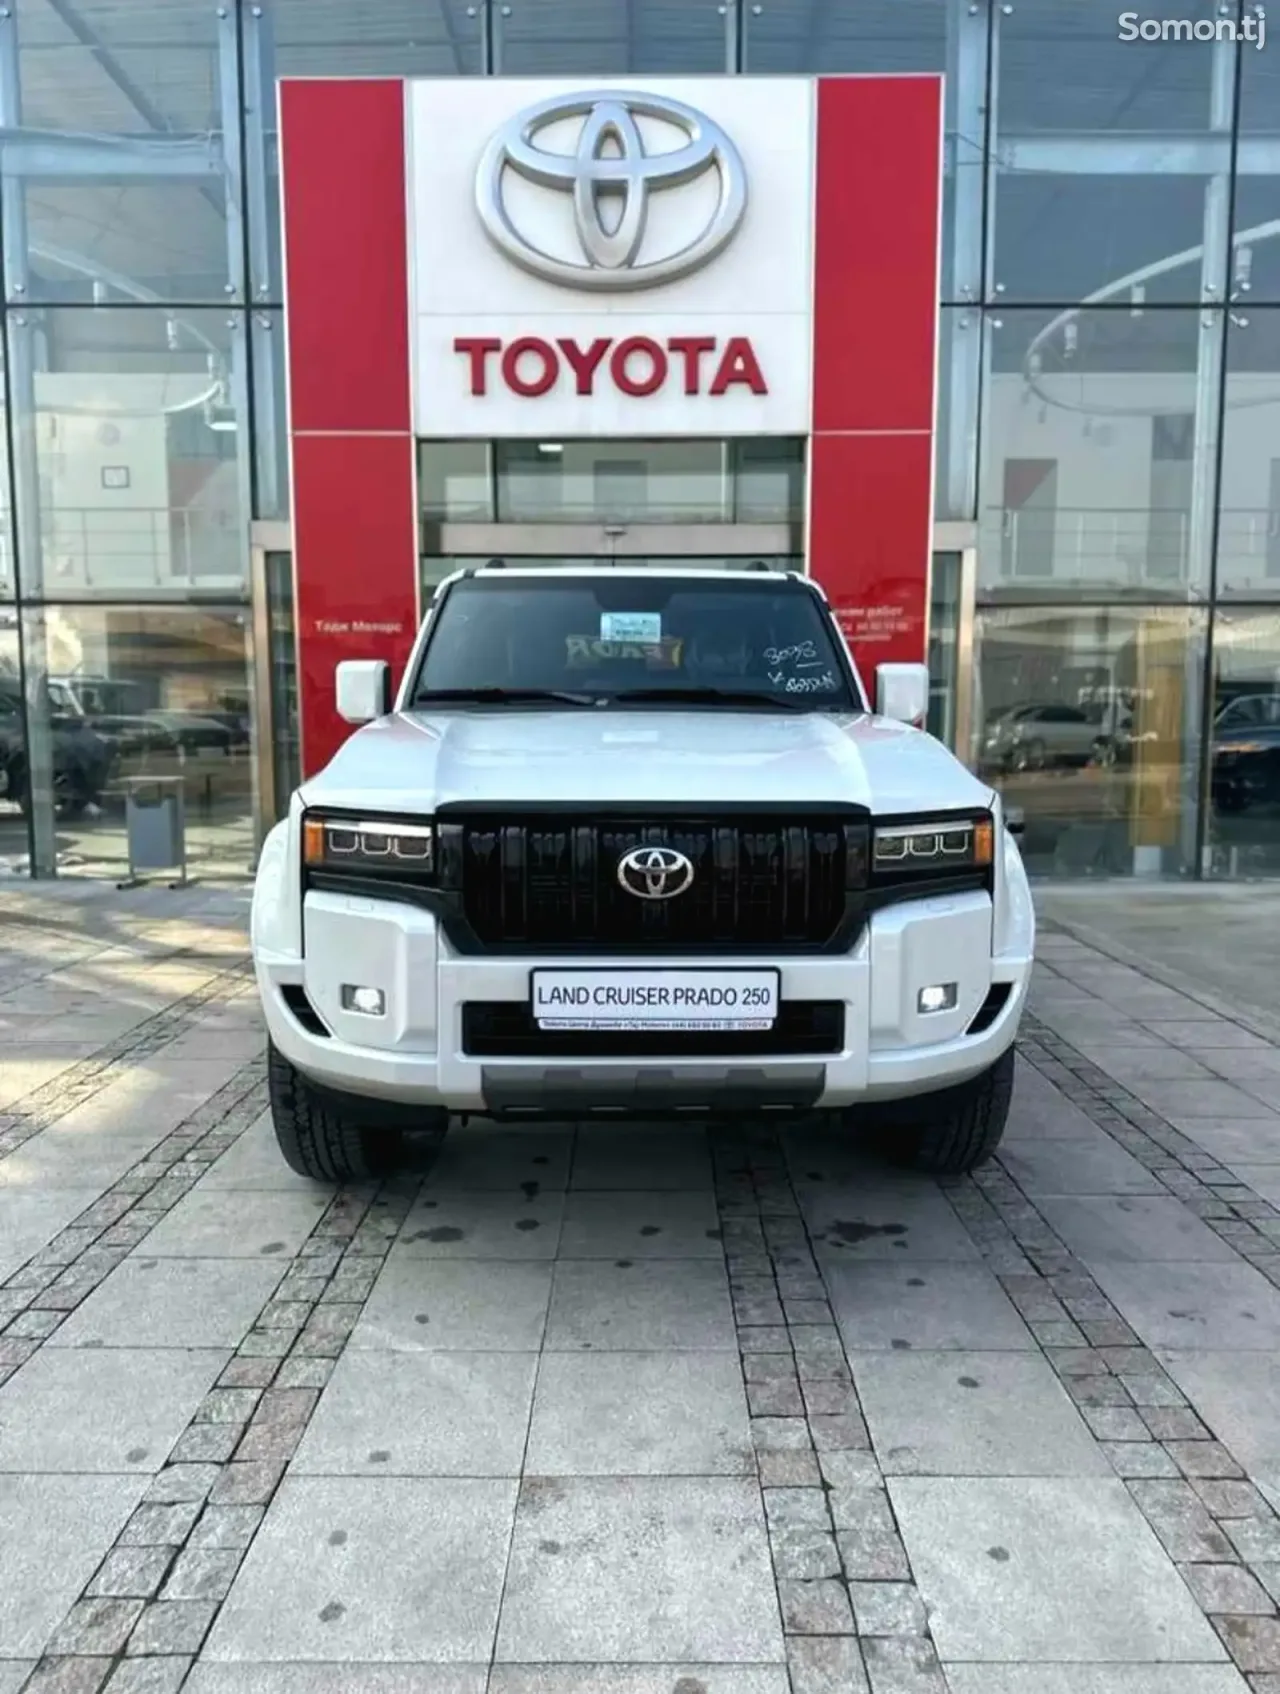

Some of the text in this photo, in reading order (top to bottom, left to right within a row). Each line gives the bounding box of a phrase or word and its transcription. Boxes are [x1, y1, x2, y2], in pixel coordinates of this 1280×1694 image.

[453, 336, 768, 397] TOYOTA
[538, 986, 771, 1006] LAND CRUISER PRADO 250
